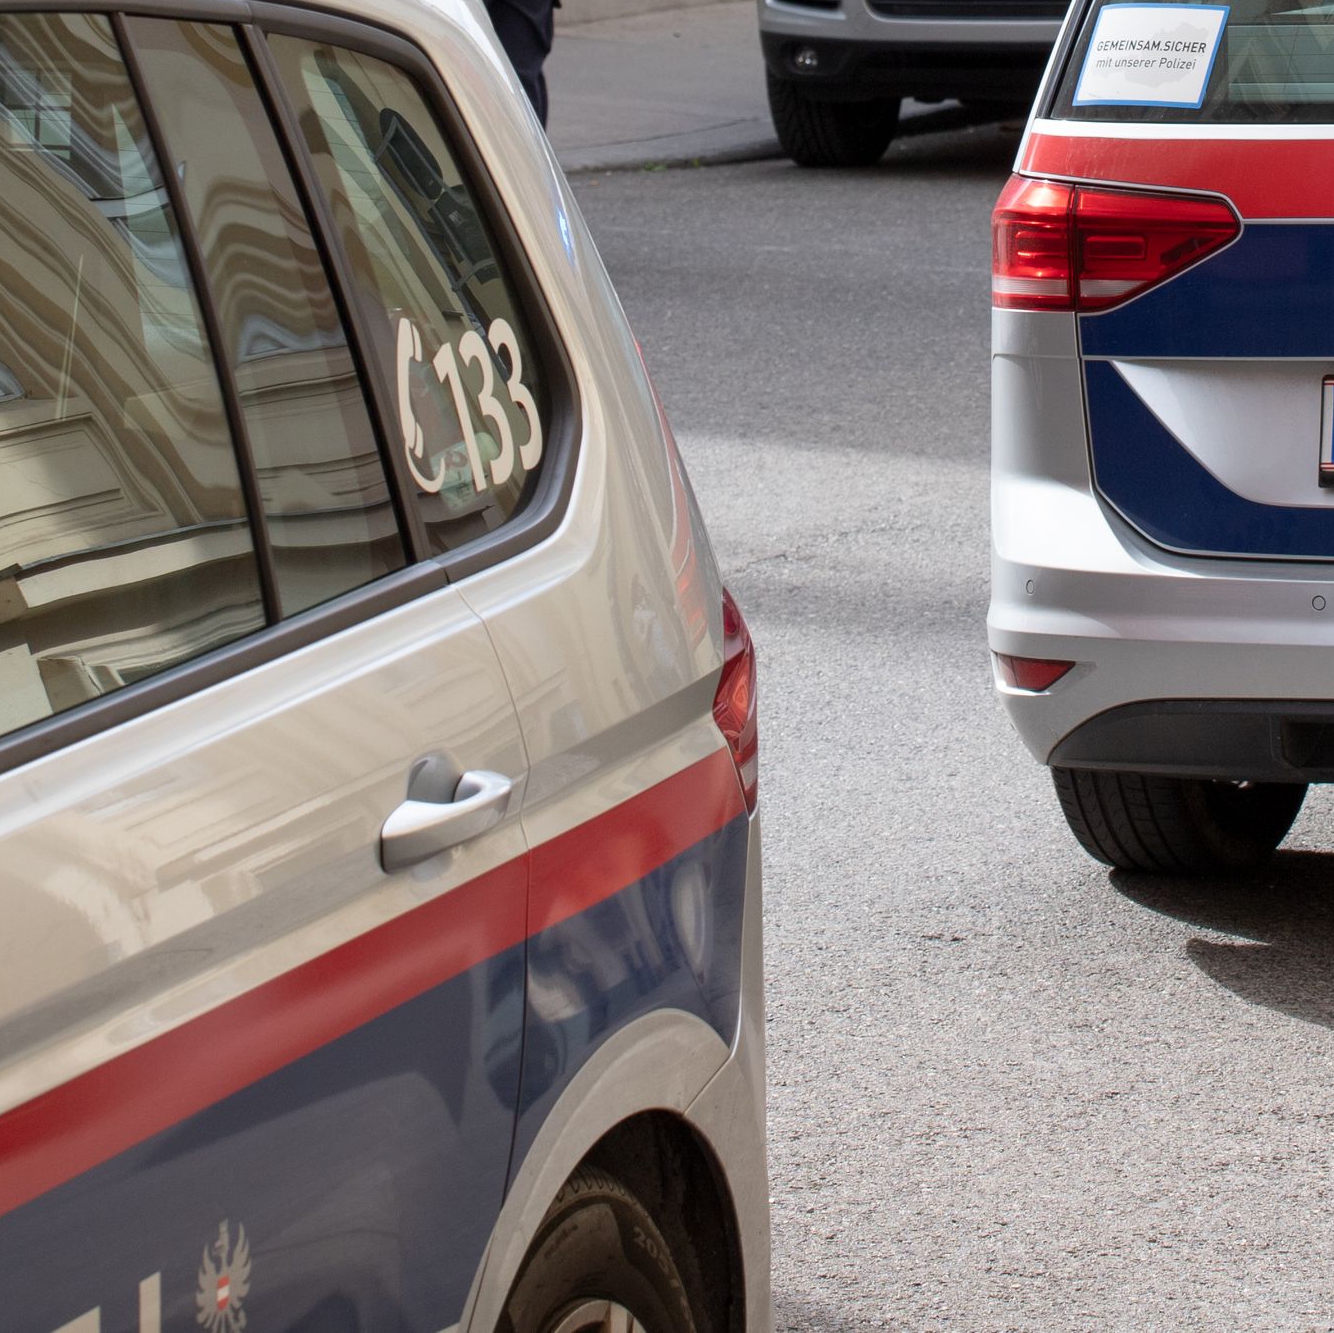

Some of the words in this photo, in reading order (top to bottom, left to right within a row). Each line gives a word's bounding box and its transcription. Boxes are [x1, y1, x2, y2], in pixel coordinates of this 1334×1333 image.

[1096, 39, 1207, 54] GEMEINSAM.SICHER
[1096, 57, 1112, 69] mit
[1114, 58, 1157, 69] unserer
[1158, 57, 1197, 70] Polizei
[432, 317, 543, 493] 133
